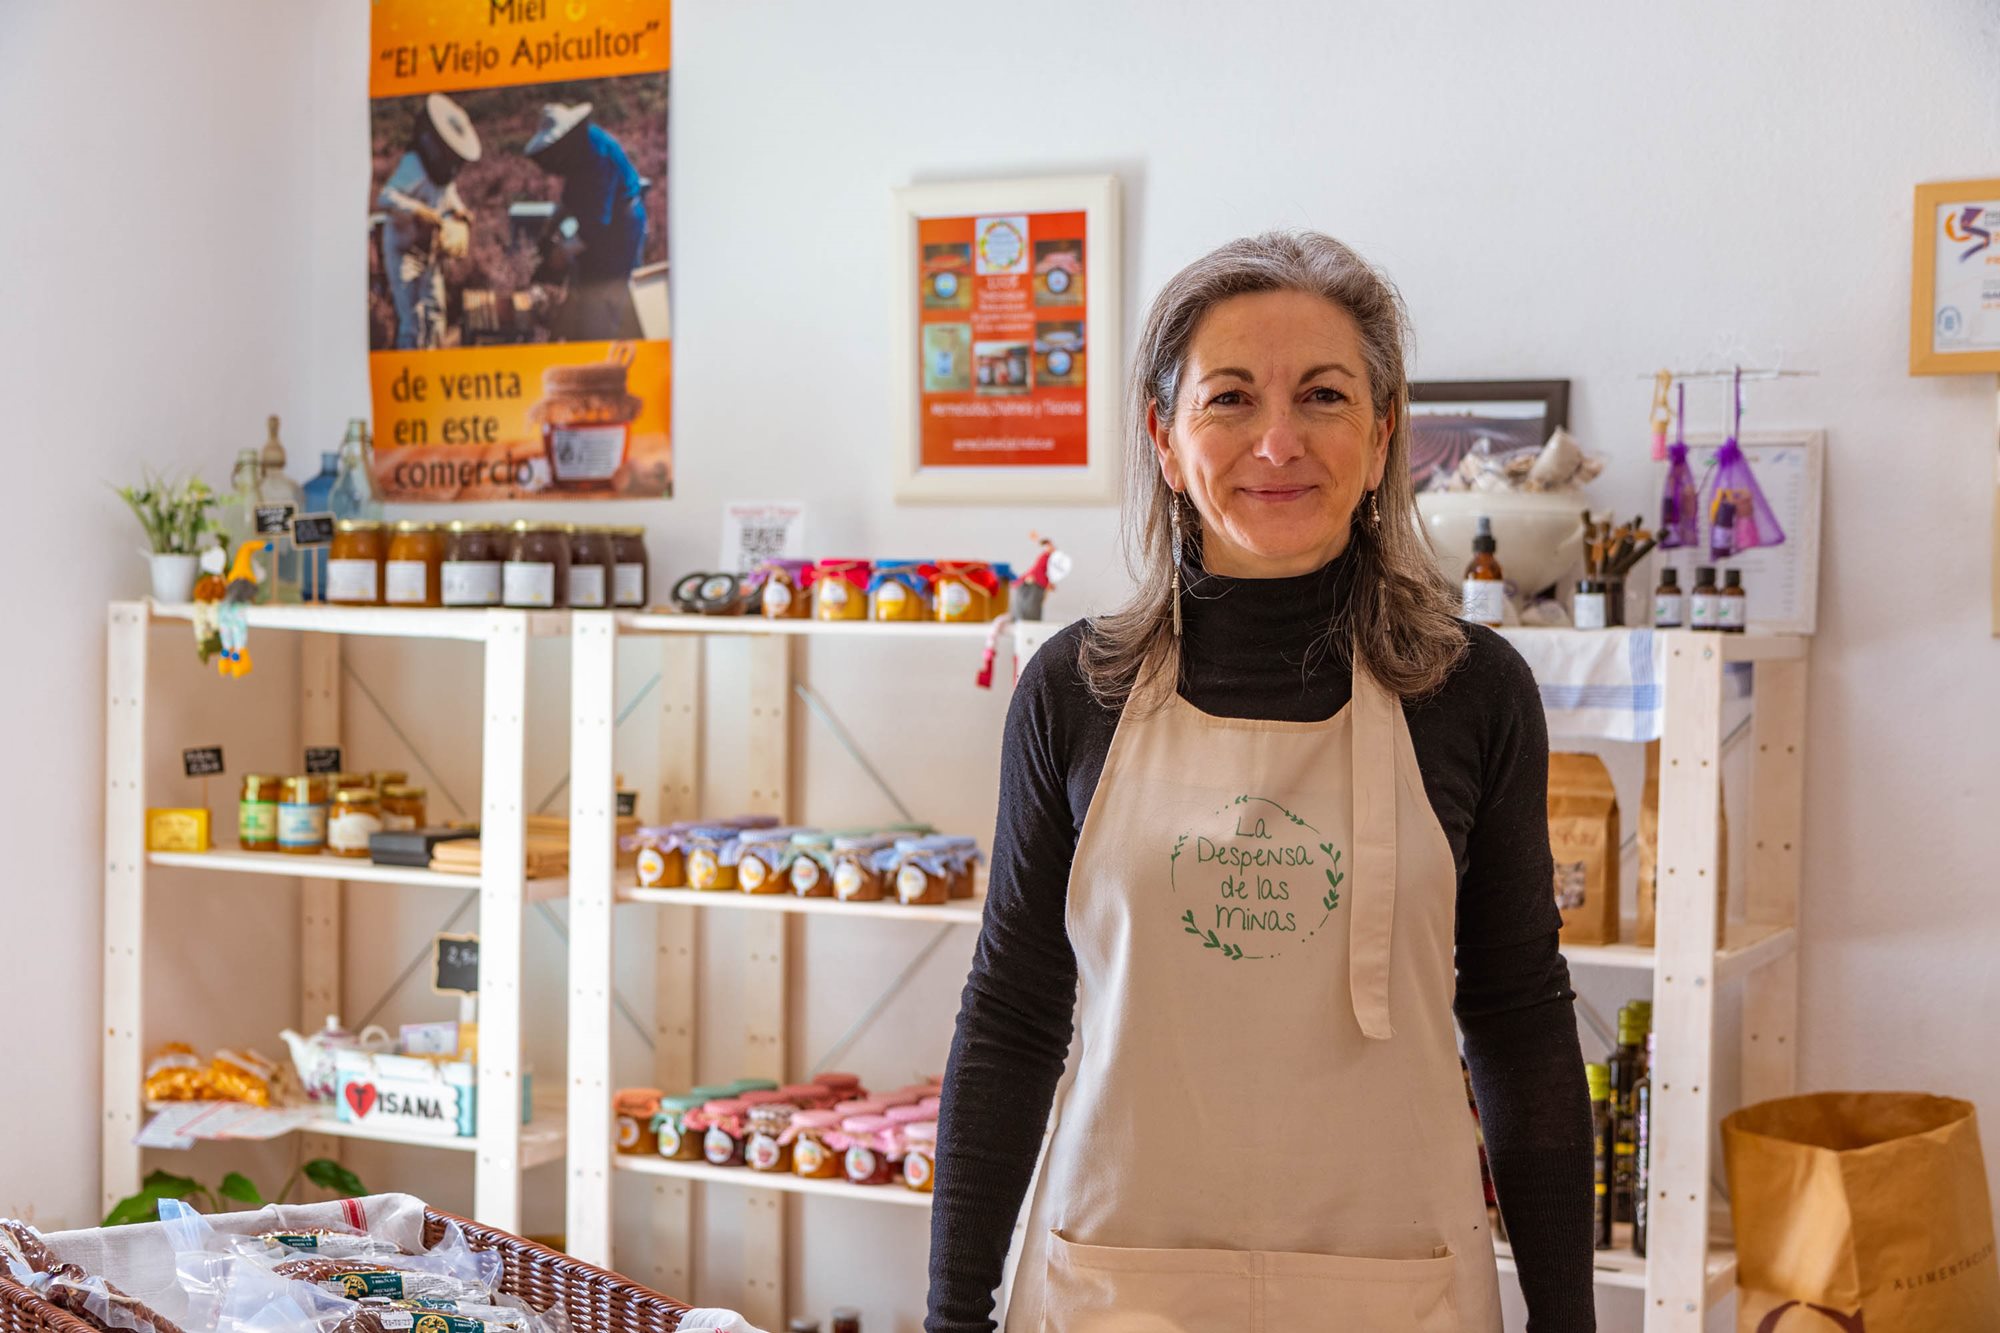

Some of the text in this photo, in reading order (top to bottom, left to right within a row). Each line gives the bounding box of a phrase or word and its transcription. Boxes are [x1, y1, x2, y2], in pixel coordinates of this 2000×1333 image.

[489, 0, 547, 26] Miel
[431, 43, 499, 76] Viejo
[391, 366, 522, 402] de venta
[394, 414, 499, 446] en este
[394, 451, 534, 489] comercio
[1235, 816, 1272, 840] La
[1221, 874, 1289, 901] de las
